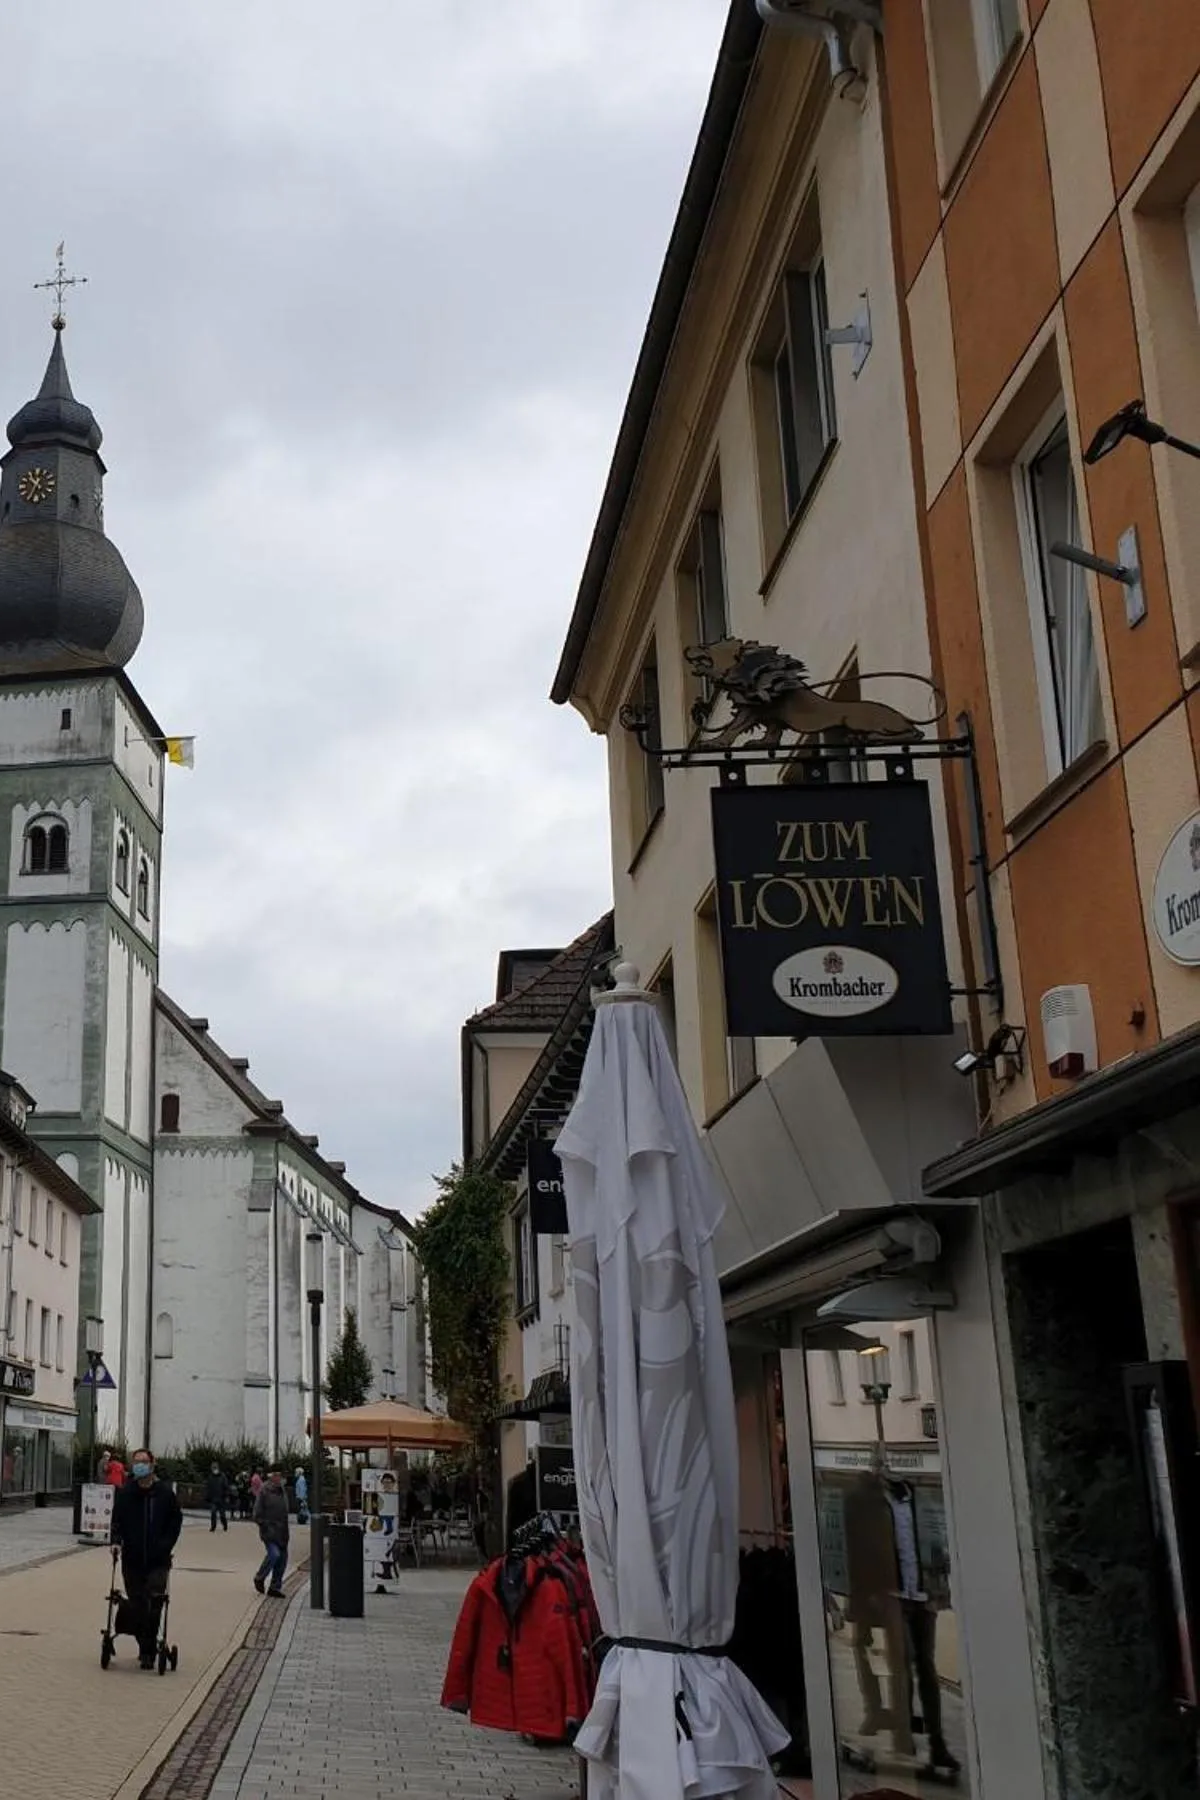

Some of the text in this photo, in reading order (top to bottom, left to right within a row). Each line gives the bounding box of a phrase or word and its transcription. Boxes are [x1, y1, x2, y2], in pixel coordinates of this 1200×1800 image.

[776, 820, 872, 862] ZUM
[728, 872, 925, 930] LÖWEN
[789, 976, 886, 998] Krombacher
[536, 1179, 563, 1193] en
